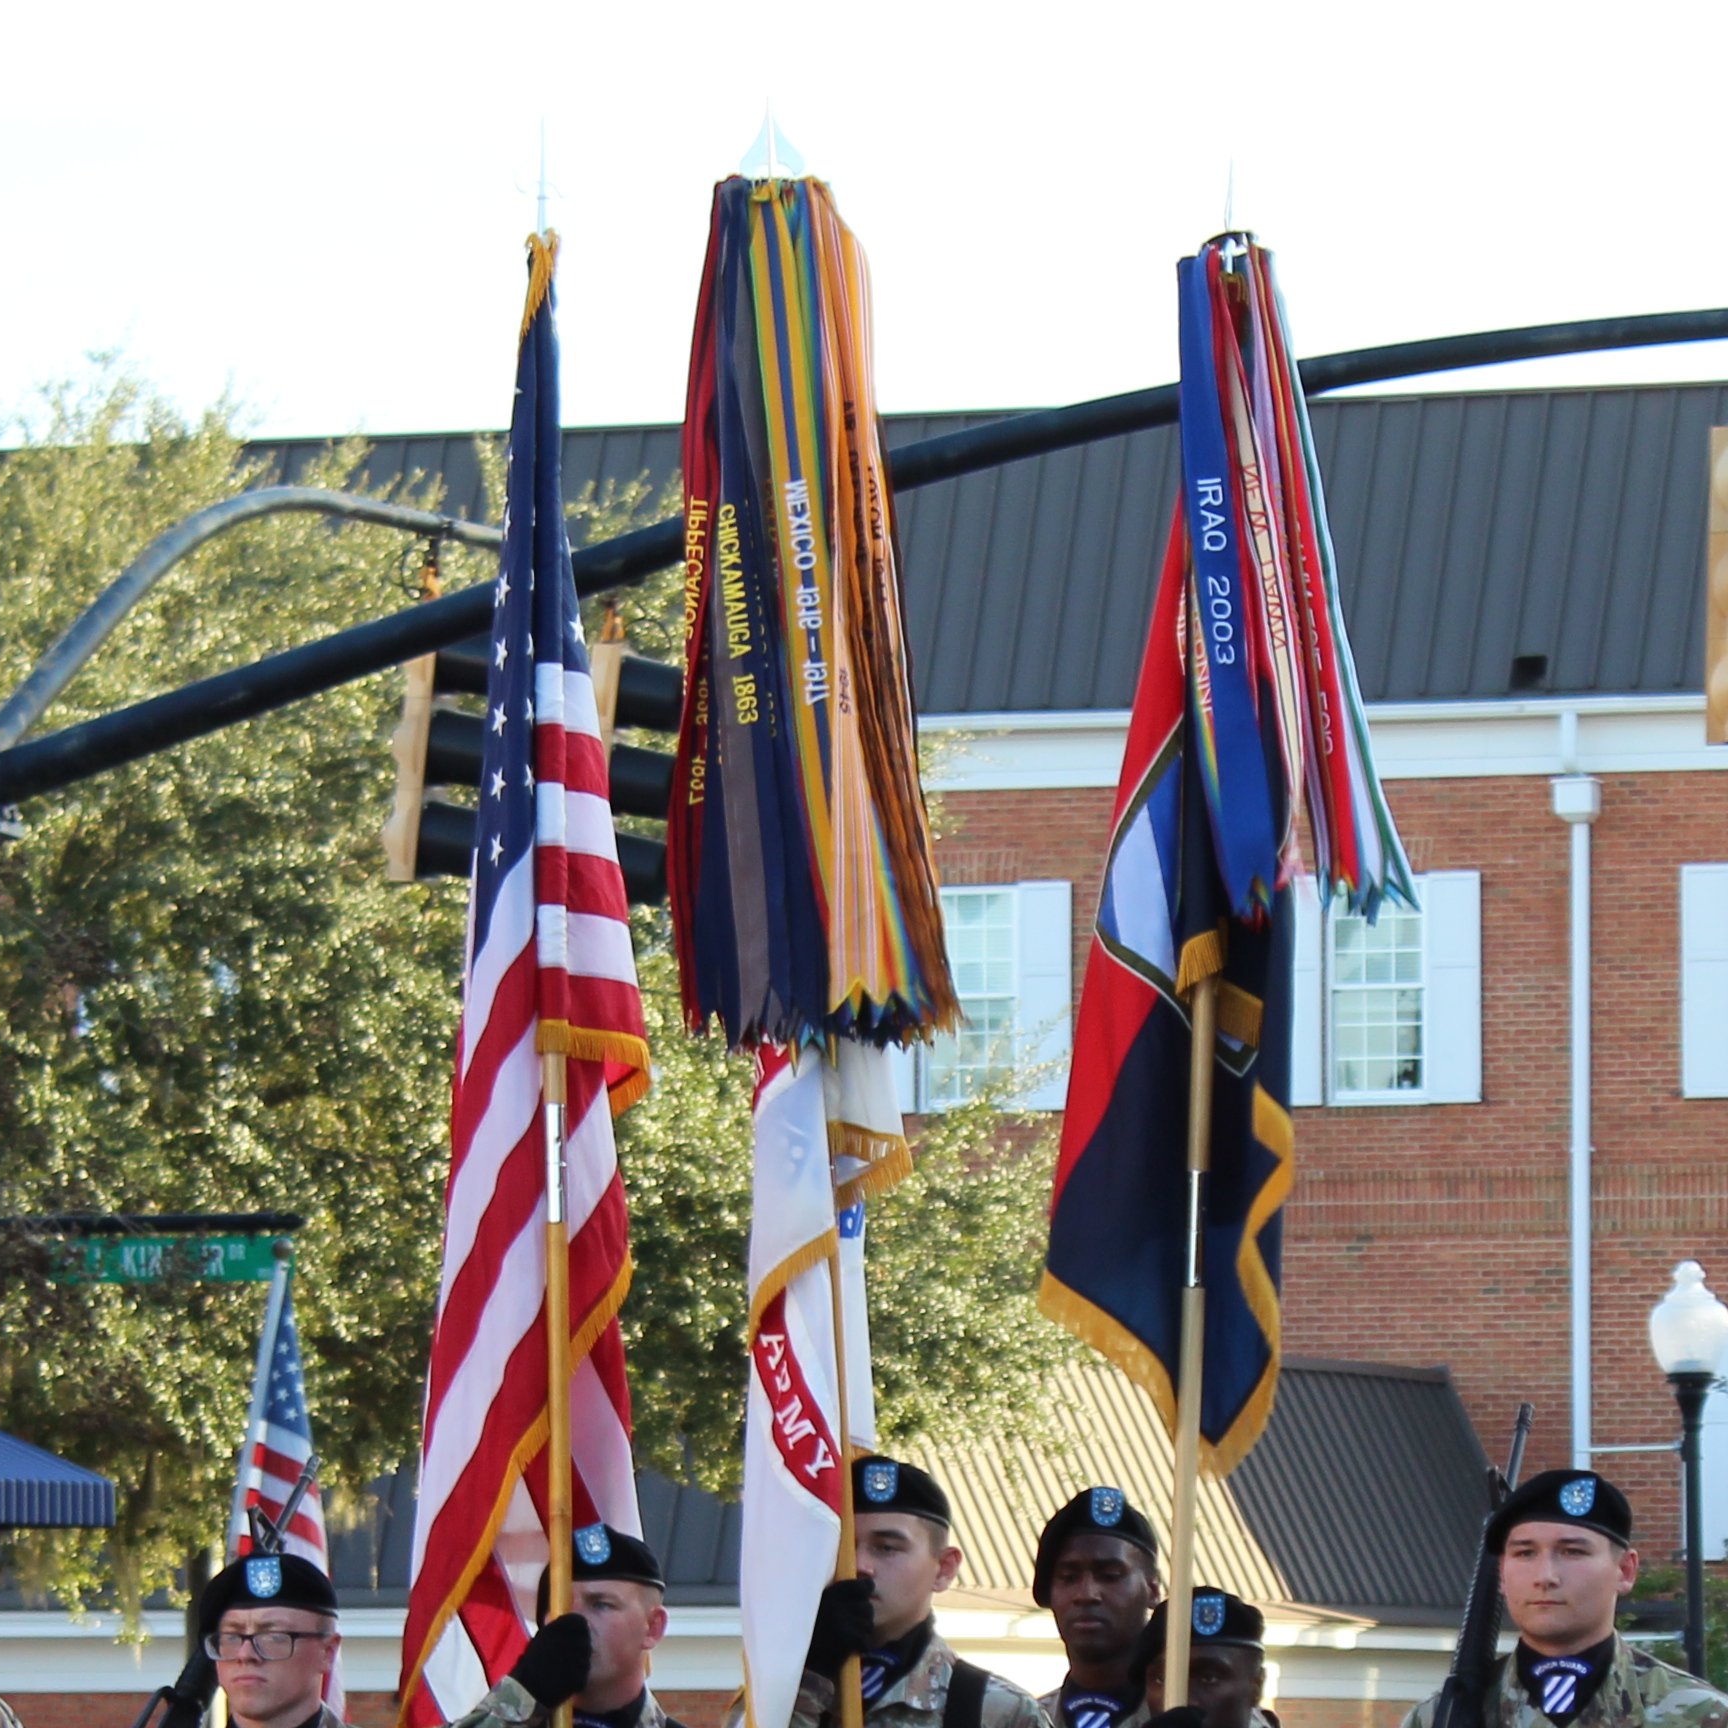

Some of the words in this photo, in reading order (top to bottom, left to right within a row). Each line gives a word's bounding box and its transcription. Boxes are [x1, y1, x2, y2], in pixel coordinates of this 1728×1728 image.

[1196, 477, 1228, 553] IRAQ
[719, 503, 752, 660] CHICKAMAUGA
[1207, 574, 1236, 665] 2003
[732, 672, 759, 725] 1863
[1559, 1660, 1589, 1675] GUARD
